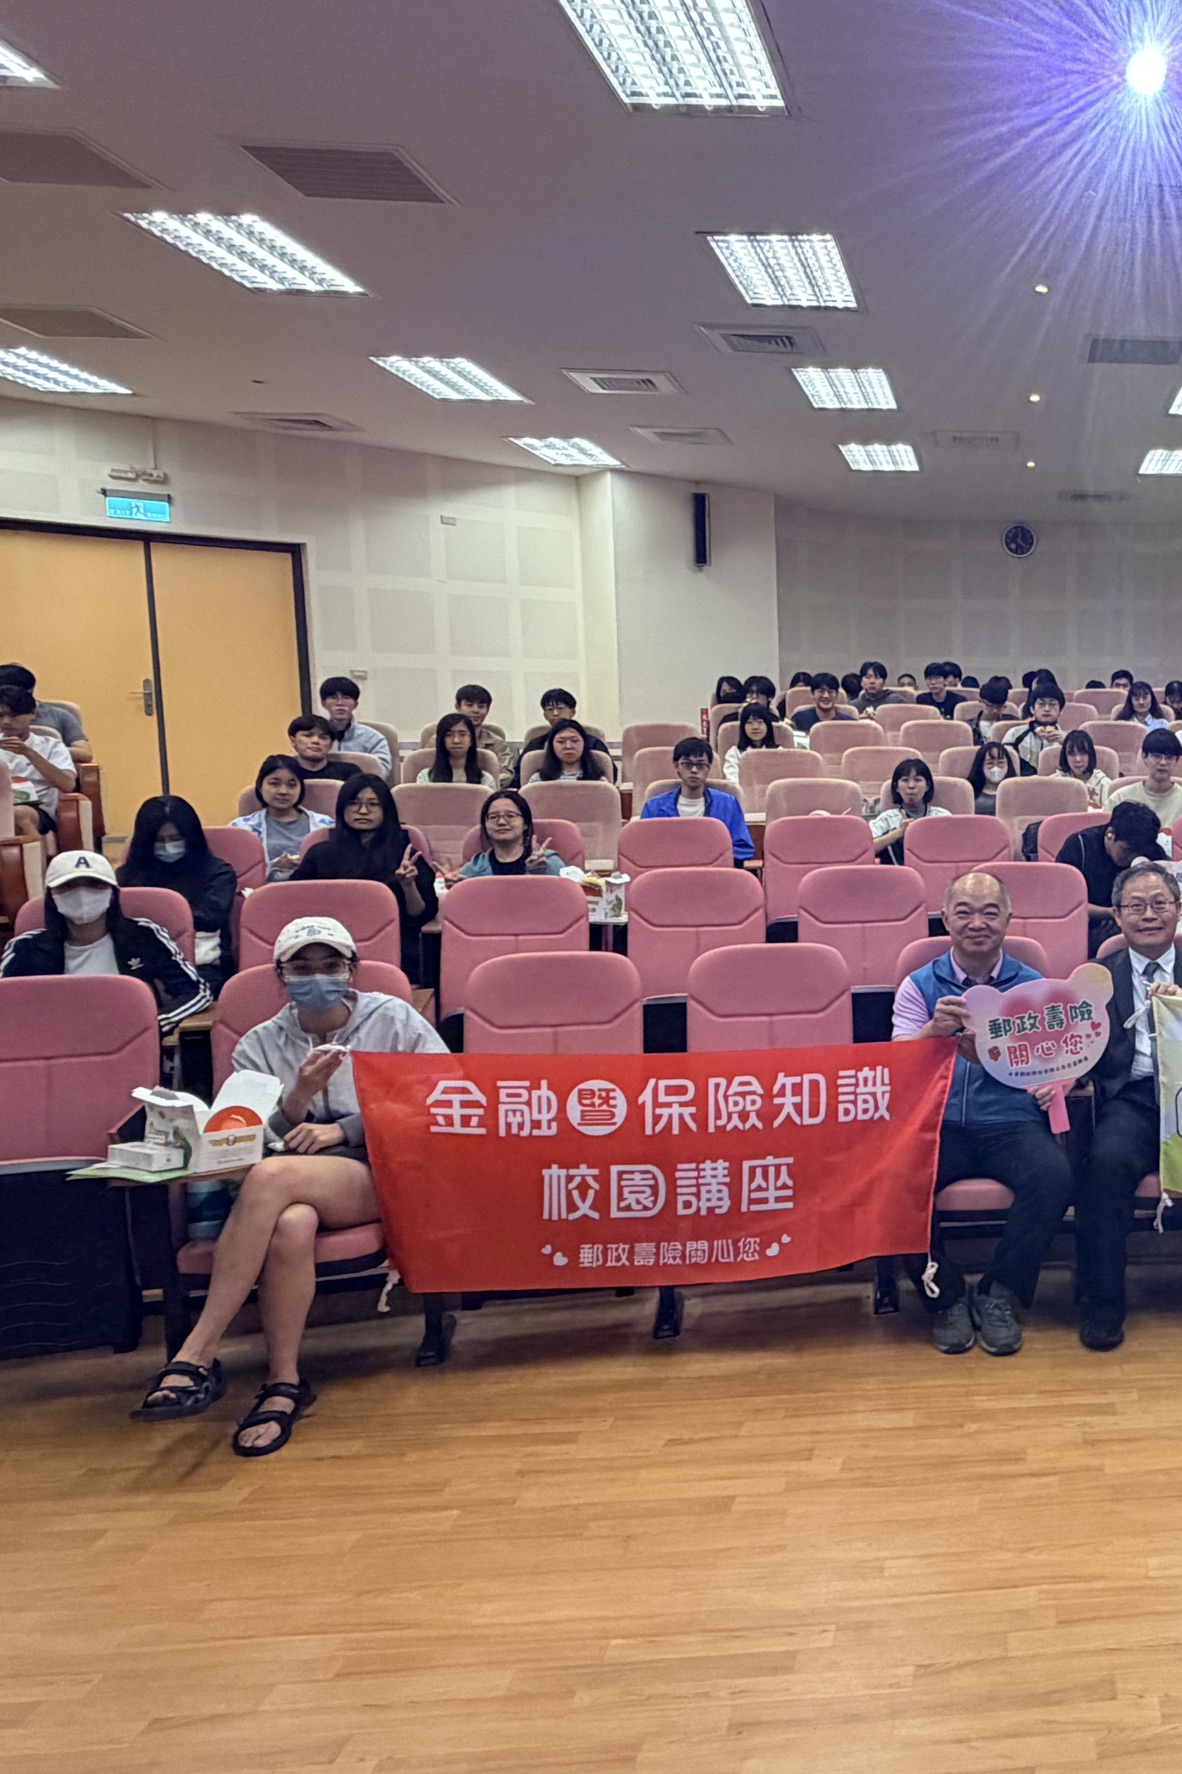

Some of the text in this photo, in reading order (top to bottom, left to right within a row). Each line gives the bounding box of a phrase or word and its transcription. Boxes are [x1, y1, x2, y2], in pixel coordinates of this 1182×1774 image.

[75, 856, 91, 869] A
[988, 1000, 1094, 1040] 郵政壽險
[1006, 1033, 1084, 1068] 關心您
[425, 1065, 892, 1137] 金融暨保險知識
[542, 1156, 795, 1221] 校園講座
[578, 1237, 761, 1268] 郵政壽險關心您
